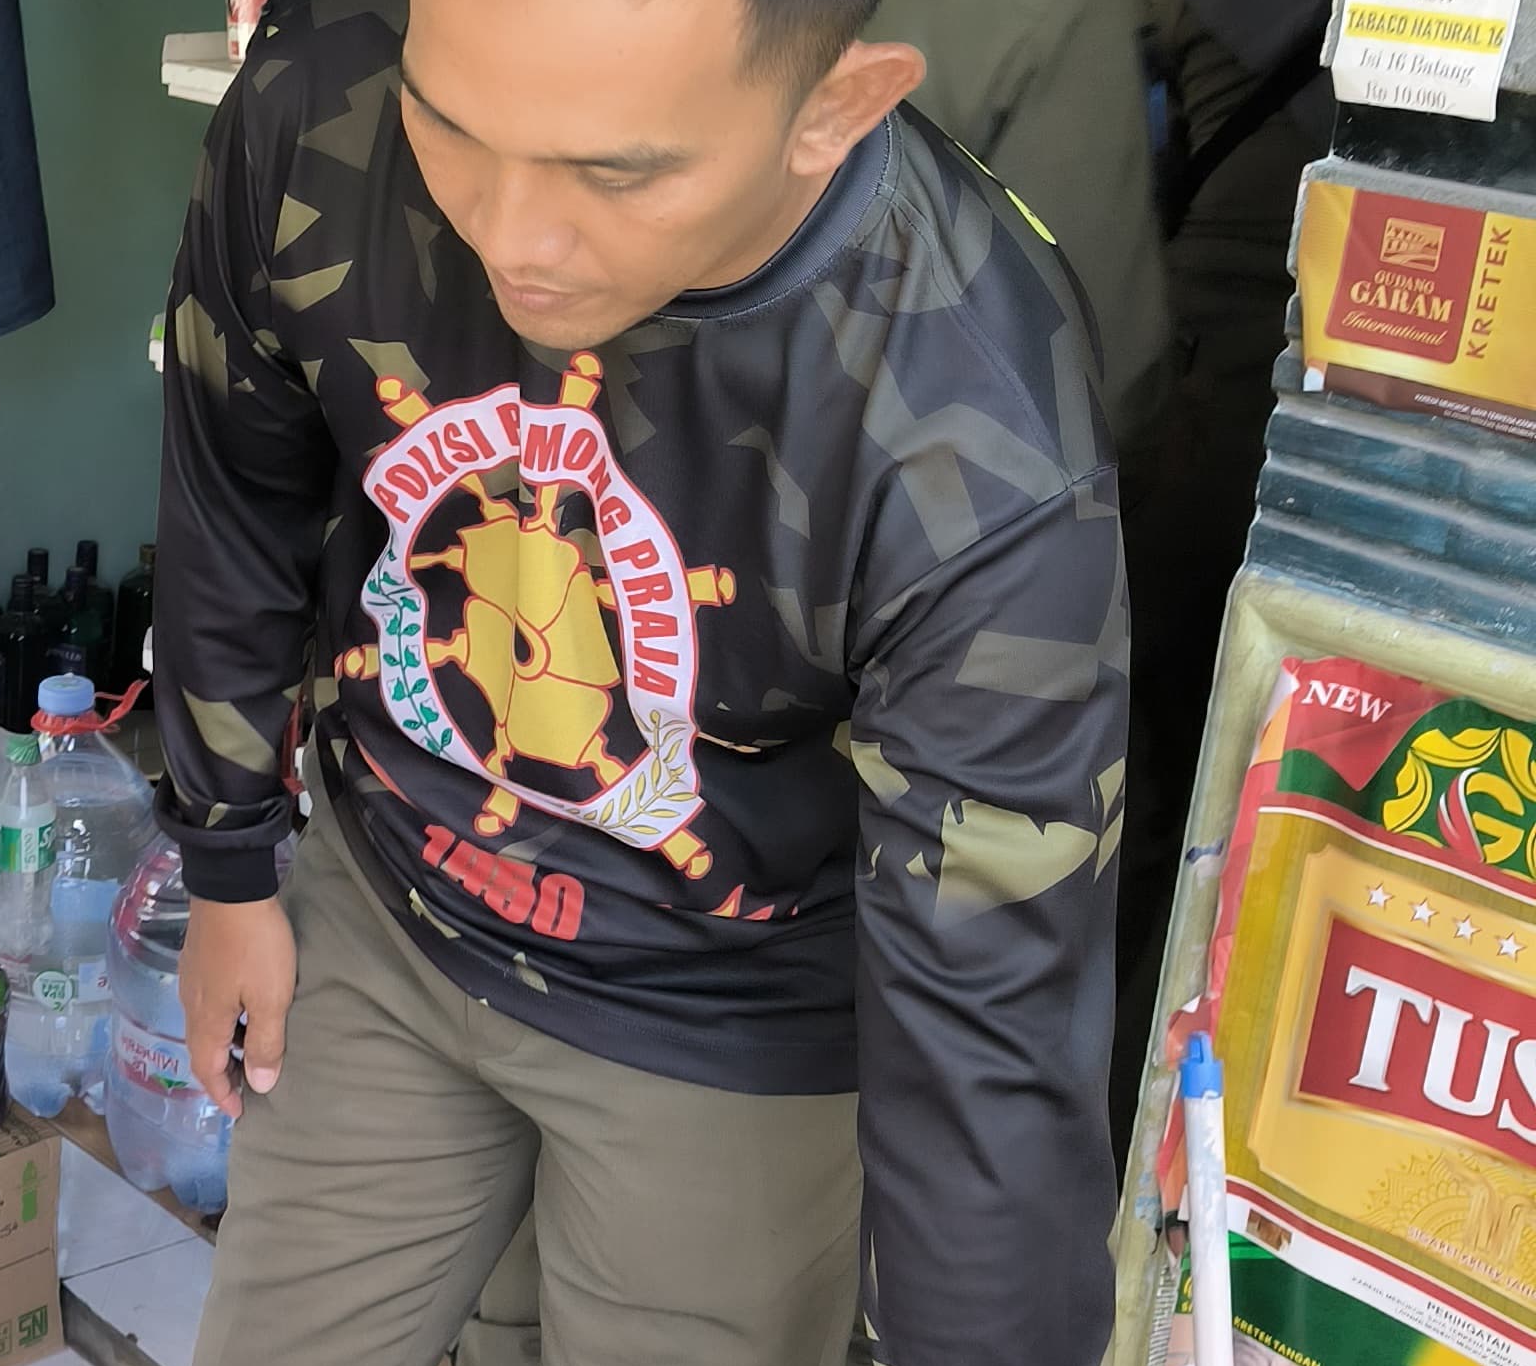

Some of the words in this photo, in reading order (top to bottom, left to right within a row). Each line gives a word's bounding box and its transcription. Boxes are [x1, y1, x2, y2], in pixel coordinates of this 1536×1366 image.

[1411, 16, 1482, 45] NATURAL
[1488, 26, 1505, 47] 16
[1388, 51, 1406, 72] 16
[1411, 54, 1475, 86] Batang
[1350, 280, 1455, 324] GARAM
[1375, 269, 1436, 295] GUDANG
[1466, 226, 1512, 359] KRETEK
[1342, 310, 1449, 347] International
[373, 418, 498, 524] POLISI
[495, 401, 632, 535] PMONG
[609, 538, 680, 698] PRAJA
[1301, 680, 1392, 723] NEW
[1426, 1299, 1513, 1355] PERINGATAN
